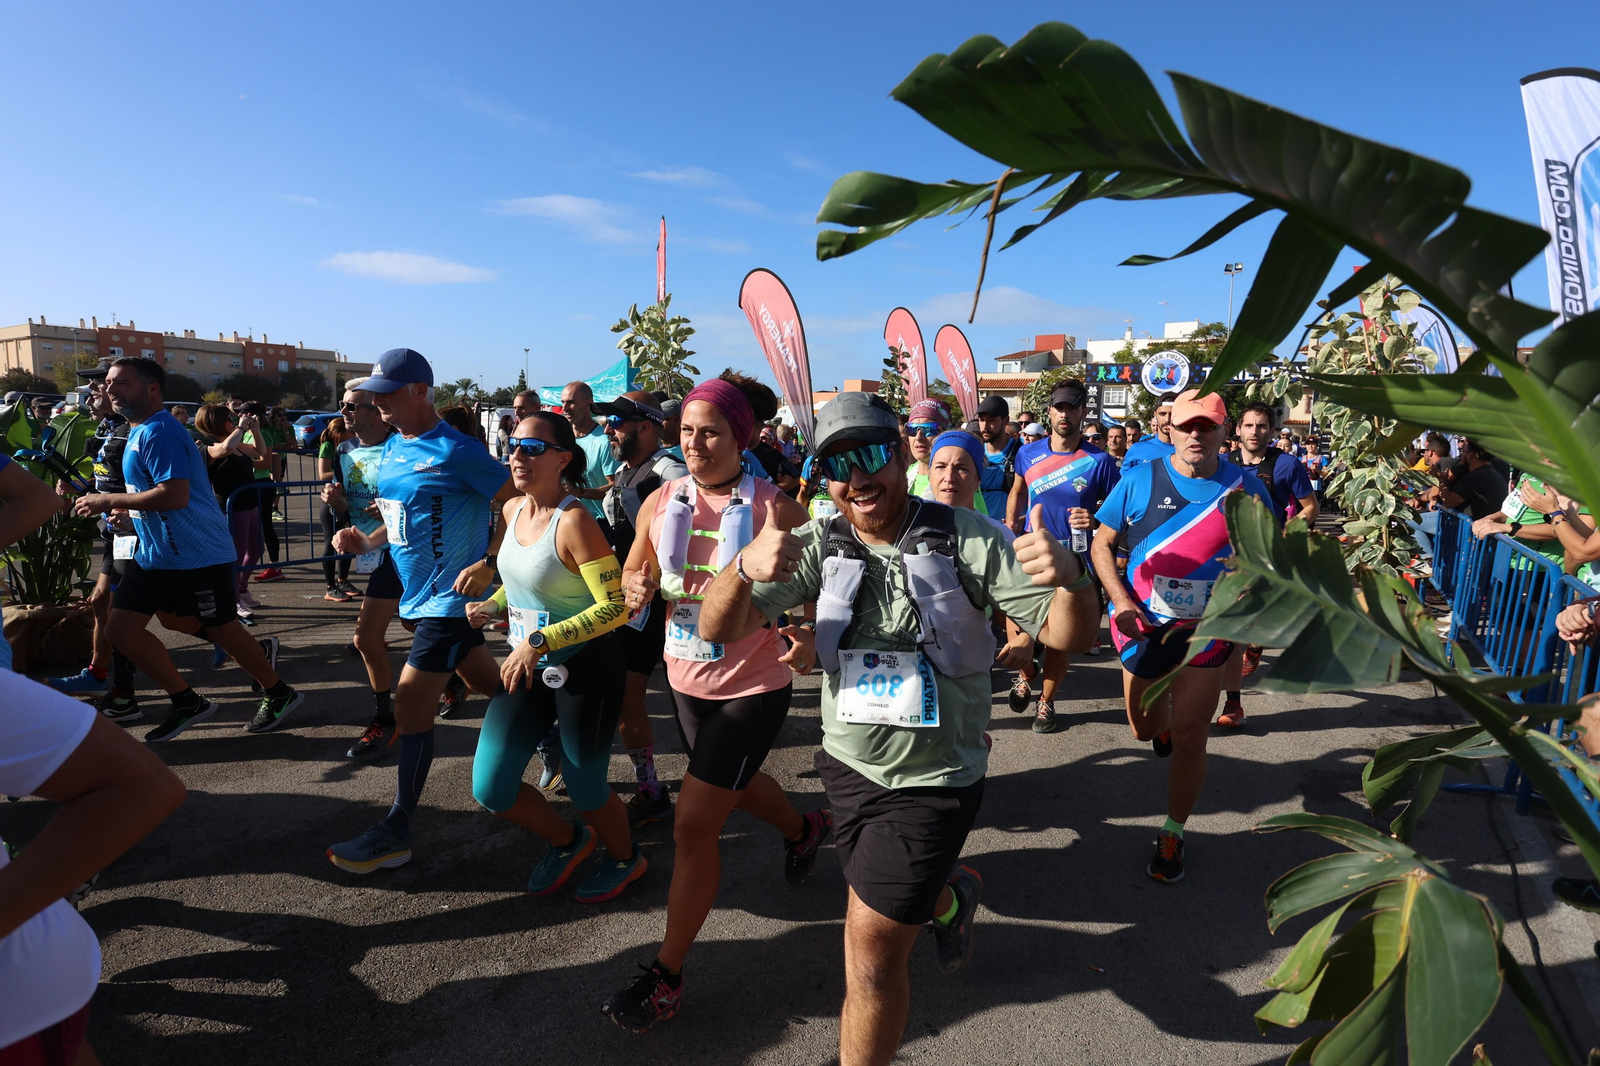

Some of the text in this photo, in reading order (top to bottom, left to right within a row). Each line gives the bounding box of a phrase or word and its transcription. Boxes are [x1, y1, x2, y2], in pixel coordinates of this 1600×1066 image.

[1047, 464, 1074, 481] JIMENA
[1034, 475, 1068, 495] RUNNERS
[431, 495, 444, 560] PIRATILLA
[1164, 591, 1194, 606] 864
[669, 623, 696, 640] 37
[856, 673, 904, 698] 608
[920, 656, 936, 721] PIRATILLA
[368, 845, 391, 858] HOKA
